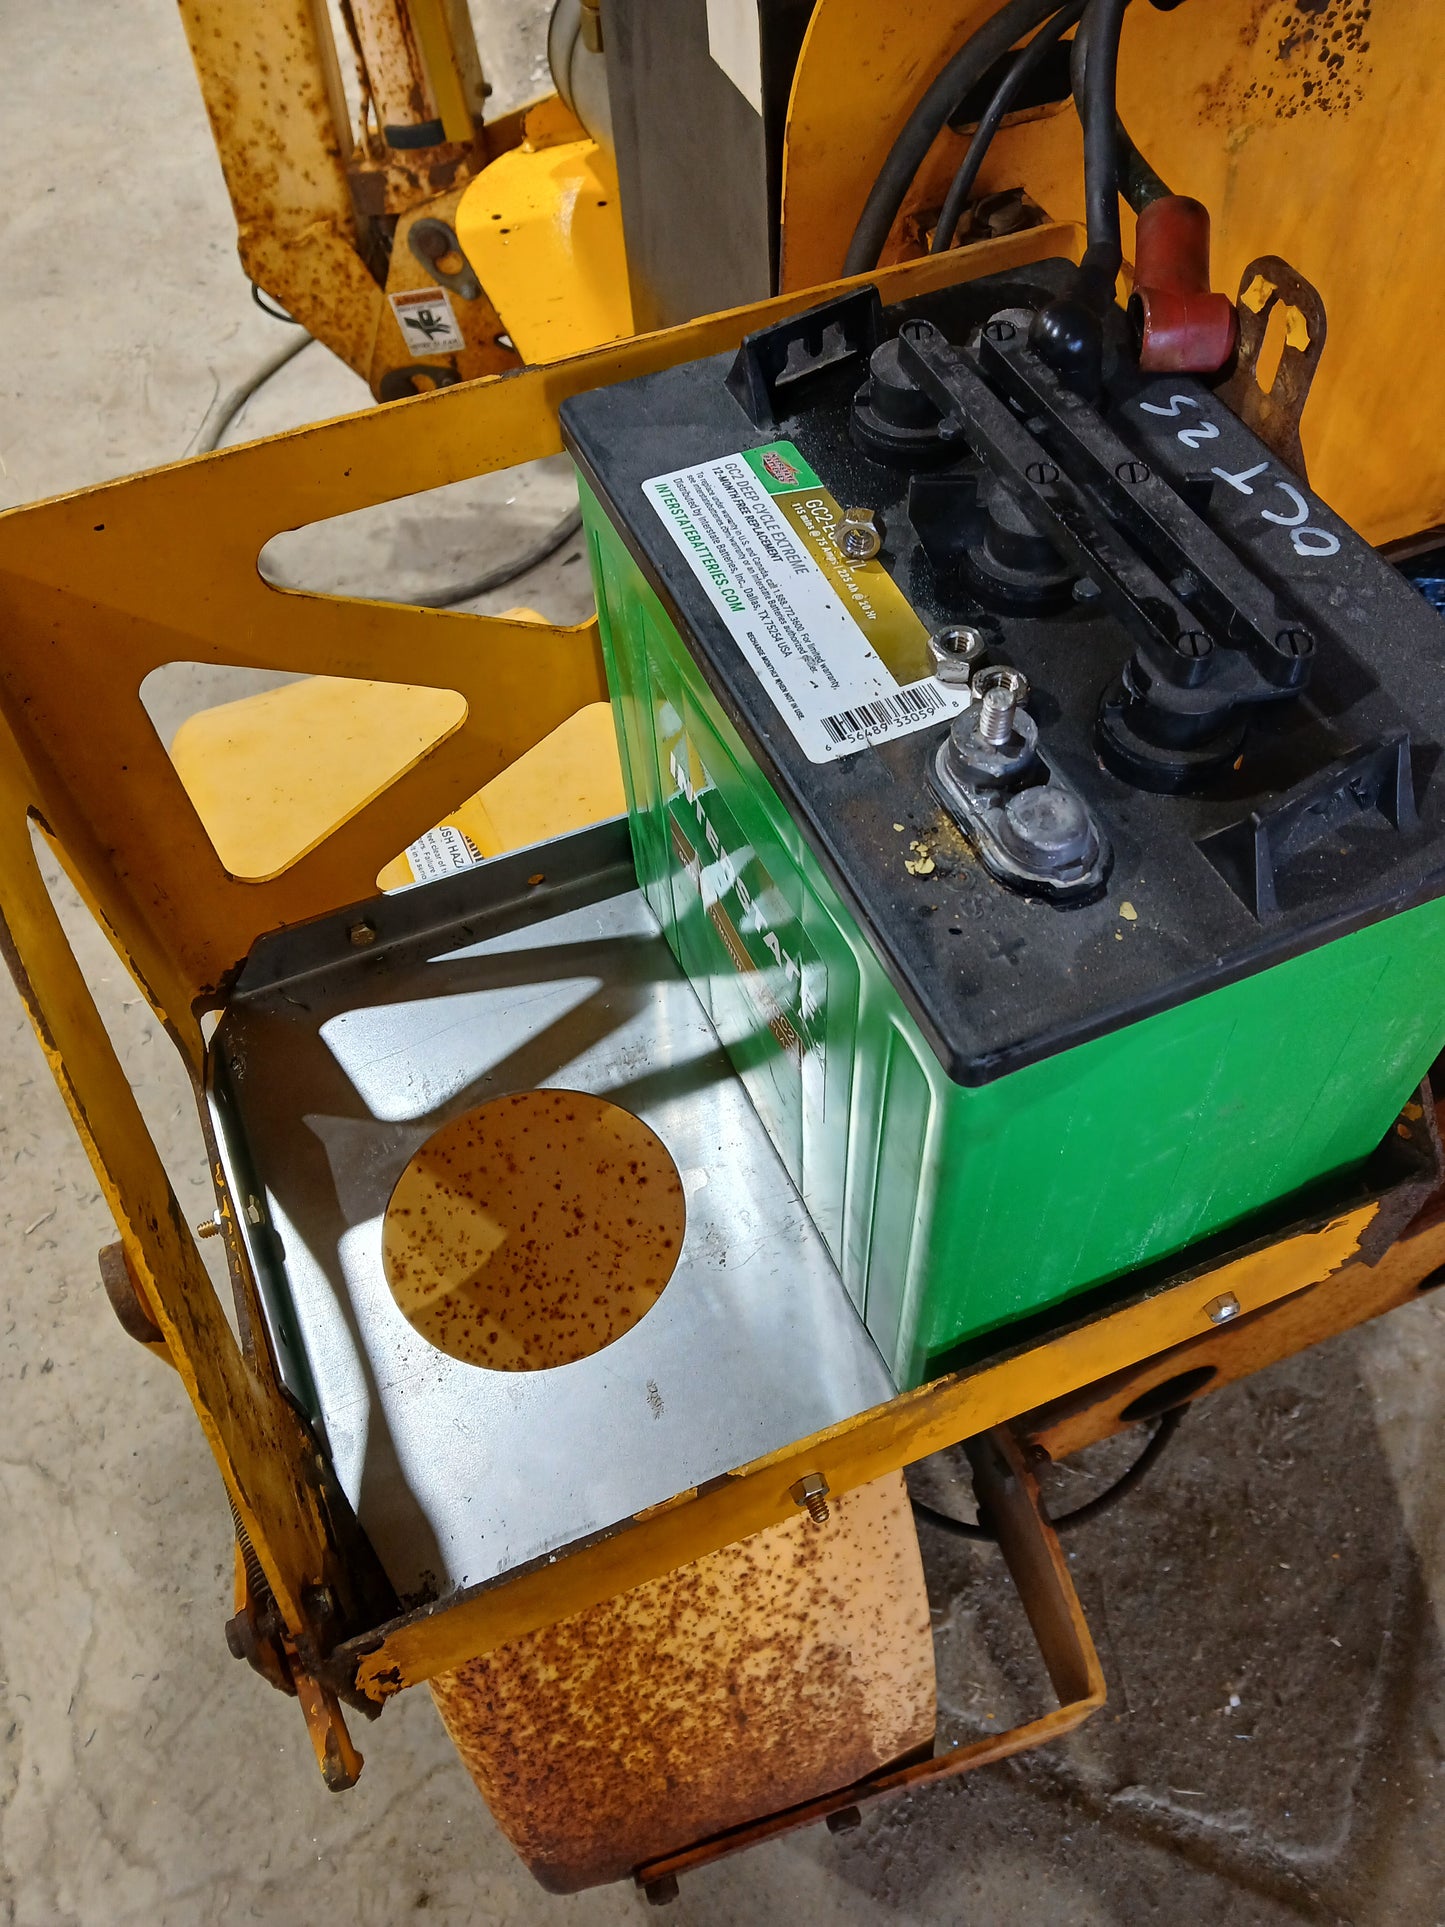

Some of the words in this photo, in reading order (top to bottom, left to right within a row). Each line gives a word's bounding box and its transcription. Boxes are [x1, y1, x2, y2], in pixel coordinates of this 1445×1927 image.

[672, 477, 699, 509] Distributed
[692, 508, 702, 516] by
[711, 466, 740, 499] 12-MONTH
[732, 499, 751, 514] FREE
[744, 515, 783, 561] REPLACEMENT
[724, 463, 744, 479] GC2
[736, 480, 759, 501] DEEP
[752, 503, 780, 531] CYCLE
[770, 531, 809, 574] EXTREME
[791, 502, 805, 514] 115
[1211, 461, 1341, 556] OCT
[698, 516, 720, 544] Interstate
[799, 514, 814, 529] mins
[654, 483, 745, 611] INTERSTATEBATTERIES.COM
[815, 536, 828, 545] 75
[686, 474, 696, 483] see
[751, 573, 771, 600] Interstate
[767, 599, 787, 624] Batteries
[783, 625, 807, 654] authorized
[715, 543, 737, 573] Batteries,
[821, 547, 841, 564] Amps
[700, 478, 715, 495] replace
[711, 496, 724, 509] under
[721, 509, 737, 530] warranty
[738, 535, 749, 546] U.S.
[745, 547, 757, 557] and
[752, 556, 768, 579] Canada,
[765, 578, 777, 589] call
[800, 632, 811, 643] For
[806, 642, 825, 663] limited
[820, 663, 839, 690] warranty,
[734, 572, 745, 588] Inc.,
[837, 569, 852, 582] 225
[743, 587, 760, 611] Dallas,
[846, 583, 858, 592] Ah
[757, 609, 770, 621] TX
[858, 600, 871, 609] 20
[865, 610, 876, 619] Hr
[763, 619, 783, 642] 75254
[777, 641, 792, 657] USA
[746, 631, 765, 656] RECHARGE
[761, 655, 778, 677] MONTHLY
[775, 678, 787, 692] WHEN
[783, 692, 794, 702] NOT
[794, 708, 804, 720] USE.
[825, 744, 832, 752] 6
[847, 722, 889, 743] 56489
[893, 707, 935, 728] 33059
[951, 700, 960, 708] 8
[447, 845, 465, 869] HAZ
